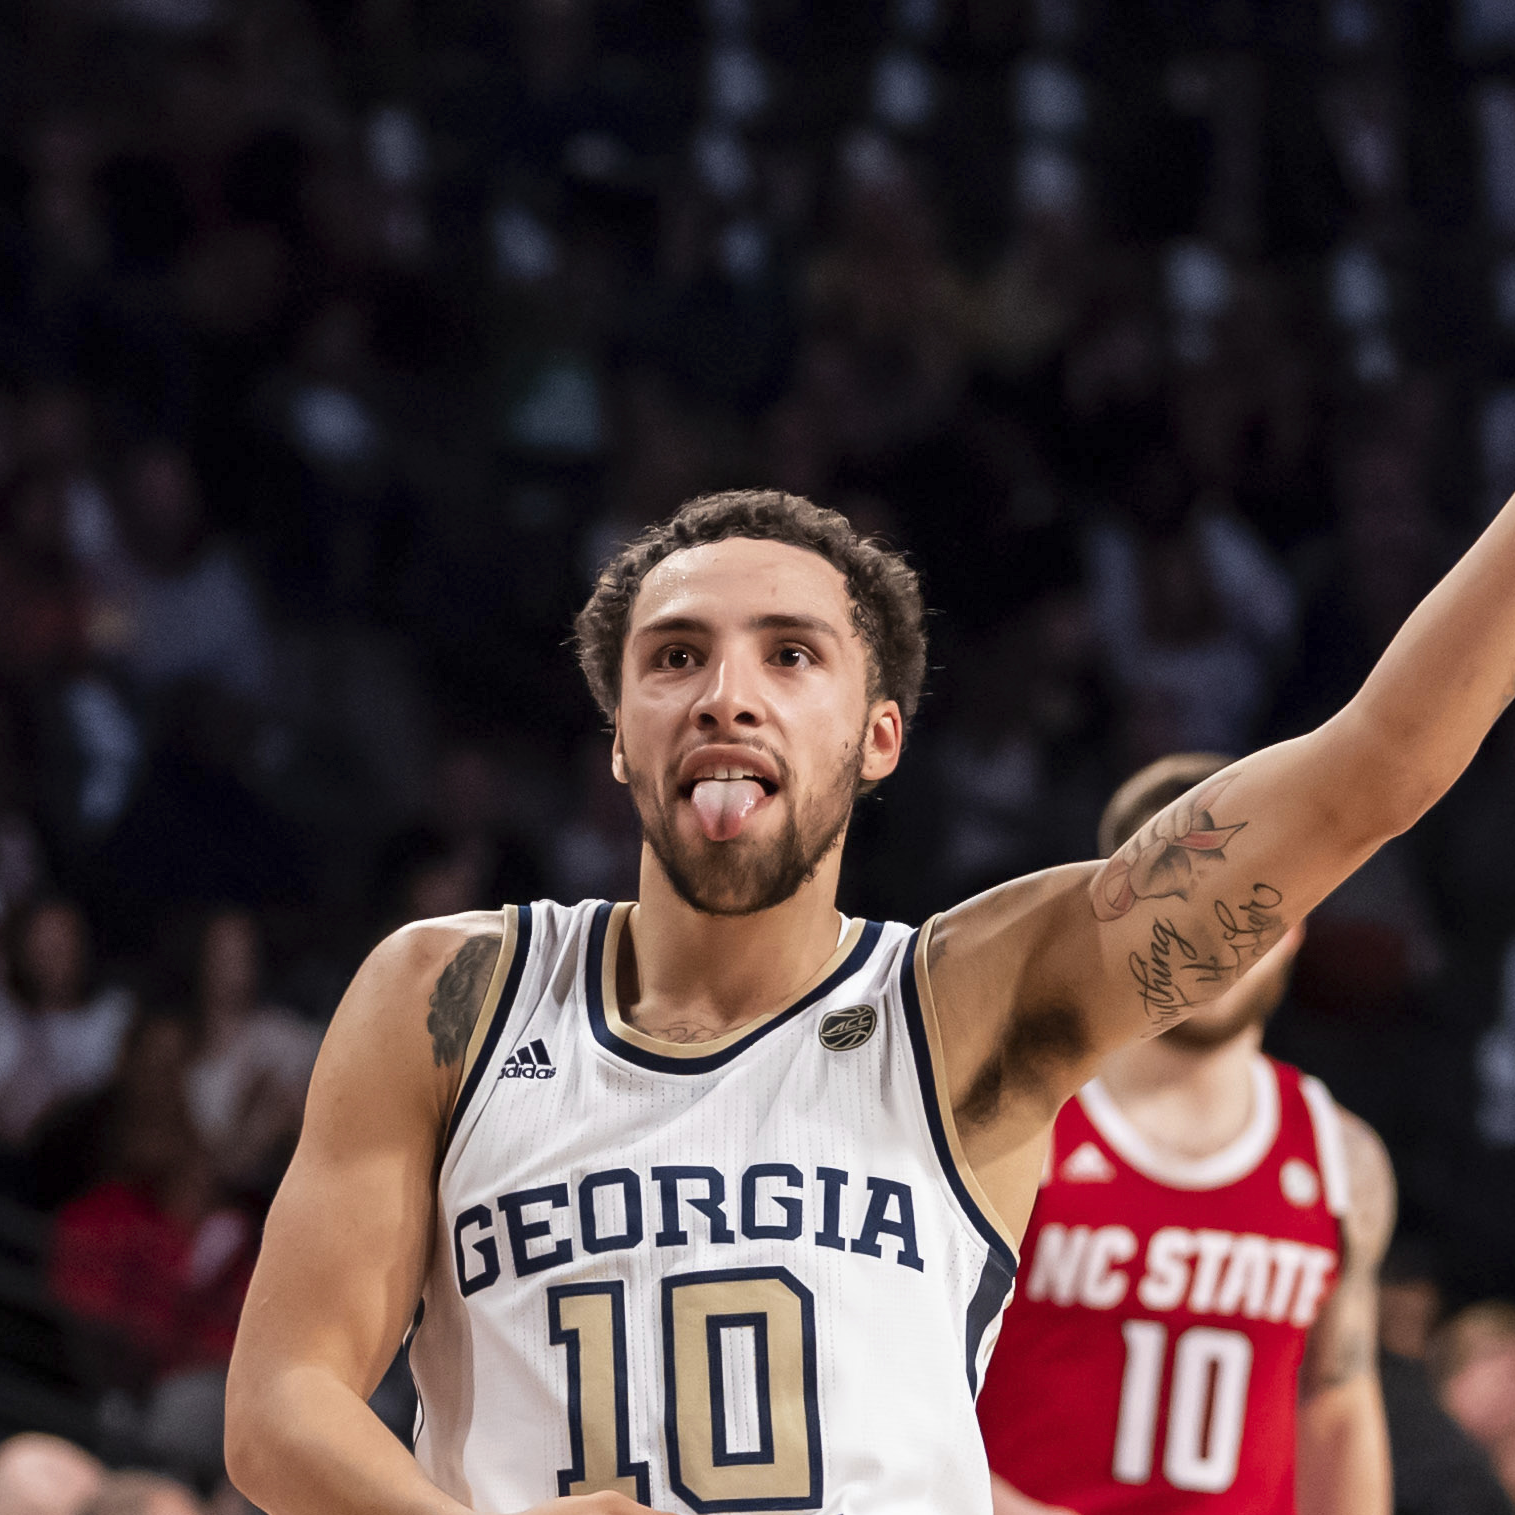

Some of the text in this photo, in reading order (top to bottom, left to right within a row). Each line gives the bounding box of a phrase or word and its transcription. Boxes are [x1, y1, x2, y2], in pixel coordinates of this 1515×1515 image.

[825, 1013, 872, 1034] ACC
[452, 1162, 925, 1297] GEORGIA
[1026, 1222, 1138, 1311] NC
[547, 1265, 824, 1515] 10
[1112, 1318, 1254, 1494] 10
